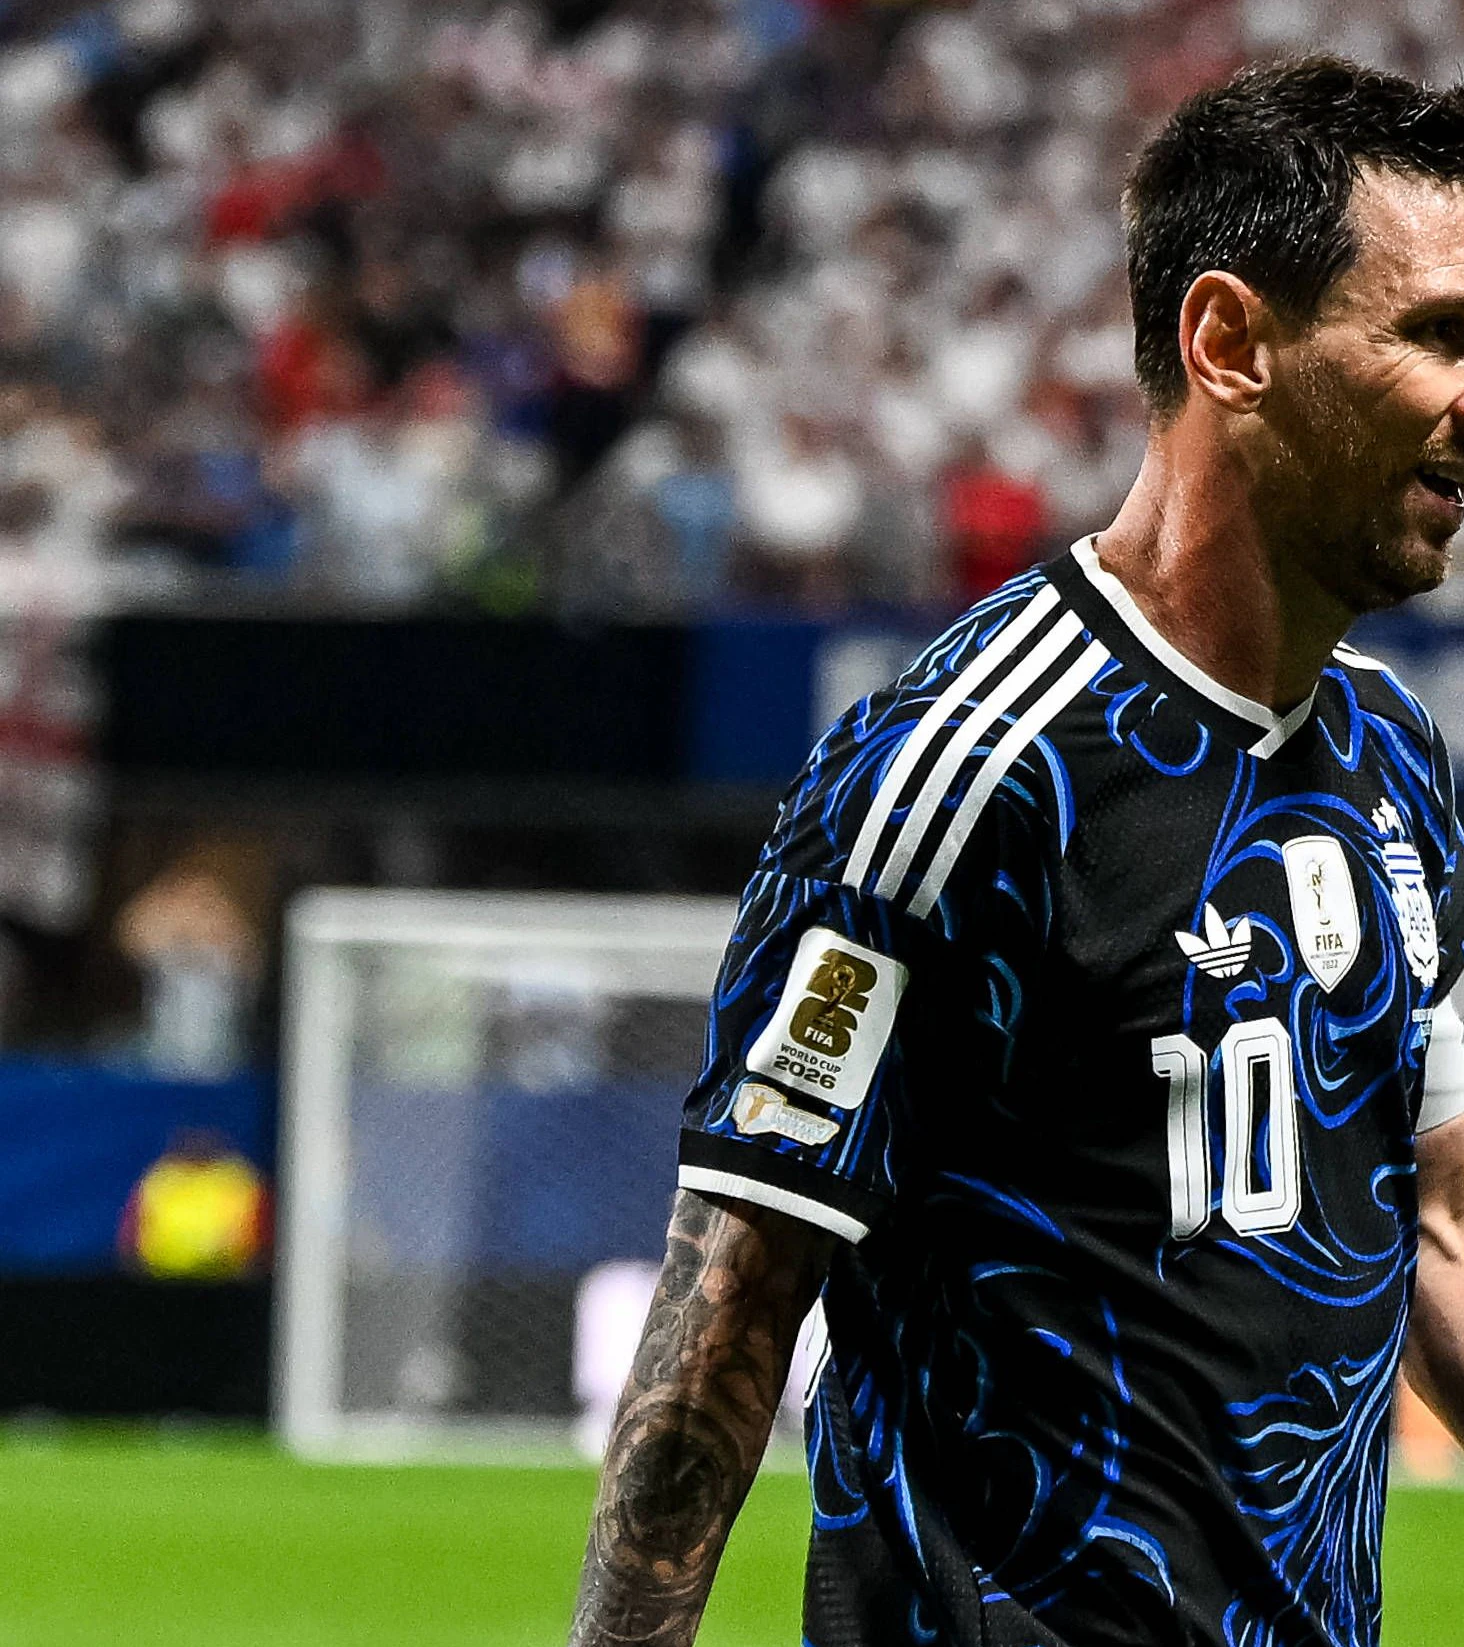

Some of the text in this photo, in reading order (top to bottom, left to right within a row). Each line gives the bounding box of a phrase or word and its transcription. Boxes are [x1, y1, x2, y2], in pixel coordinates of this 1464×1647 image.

[1315, 933, 1343, 951] FIFA
[804, 1027, 834, 1048] FIFA
[773, 1055, 837, 1090] 2026
[780, 1043, 842, 1074] WORLD CUP
[1151, 1016, 1301, 1241] 10
